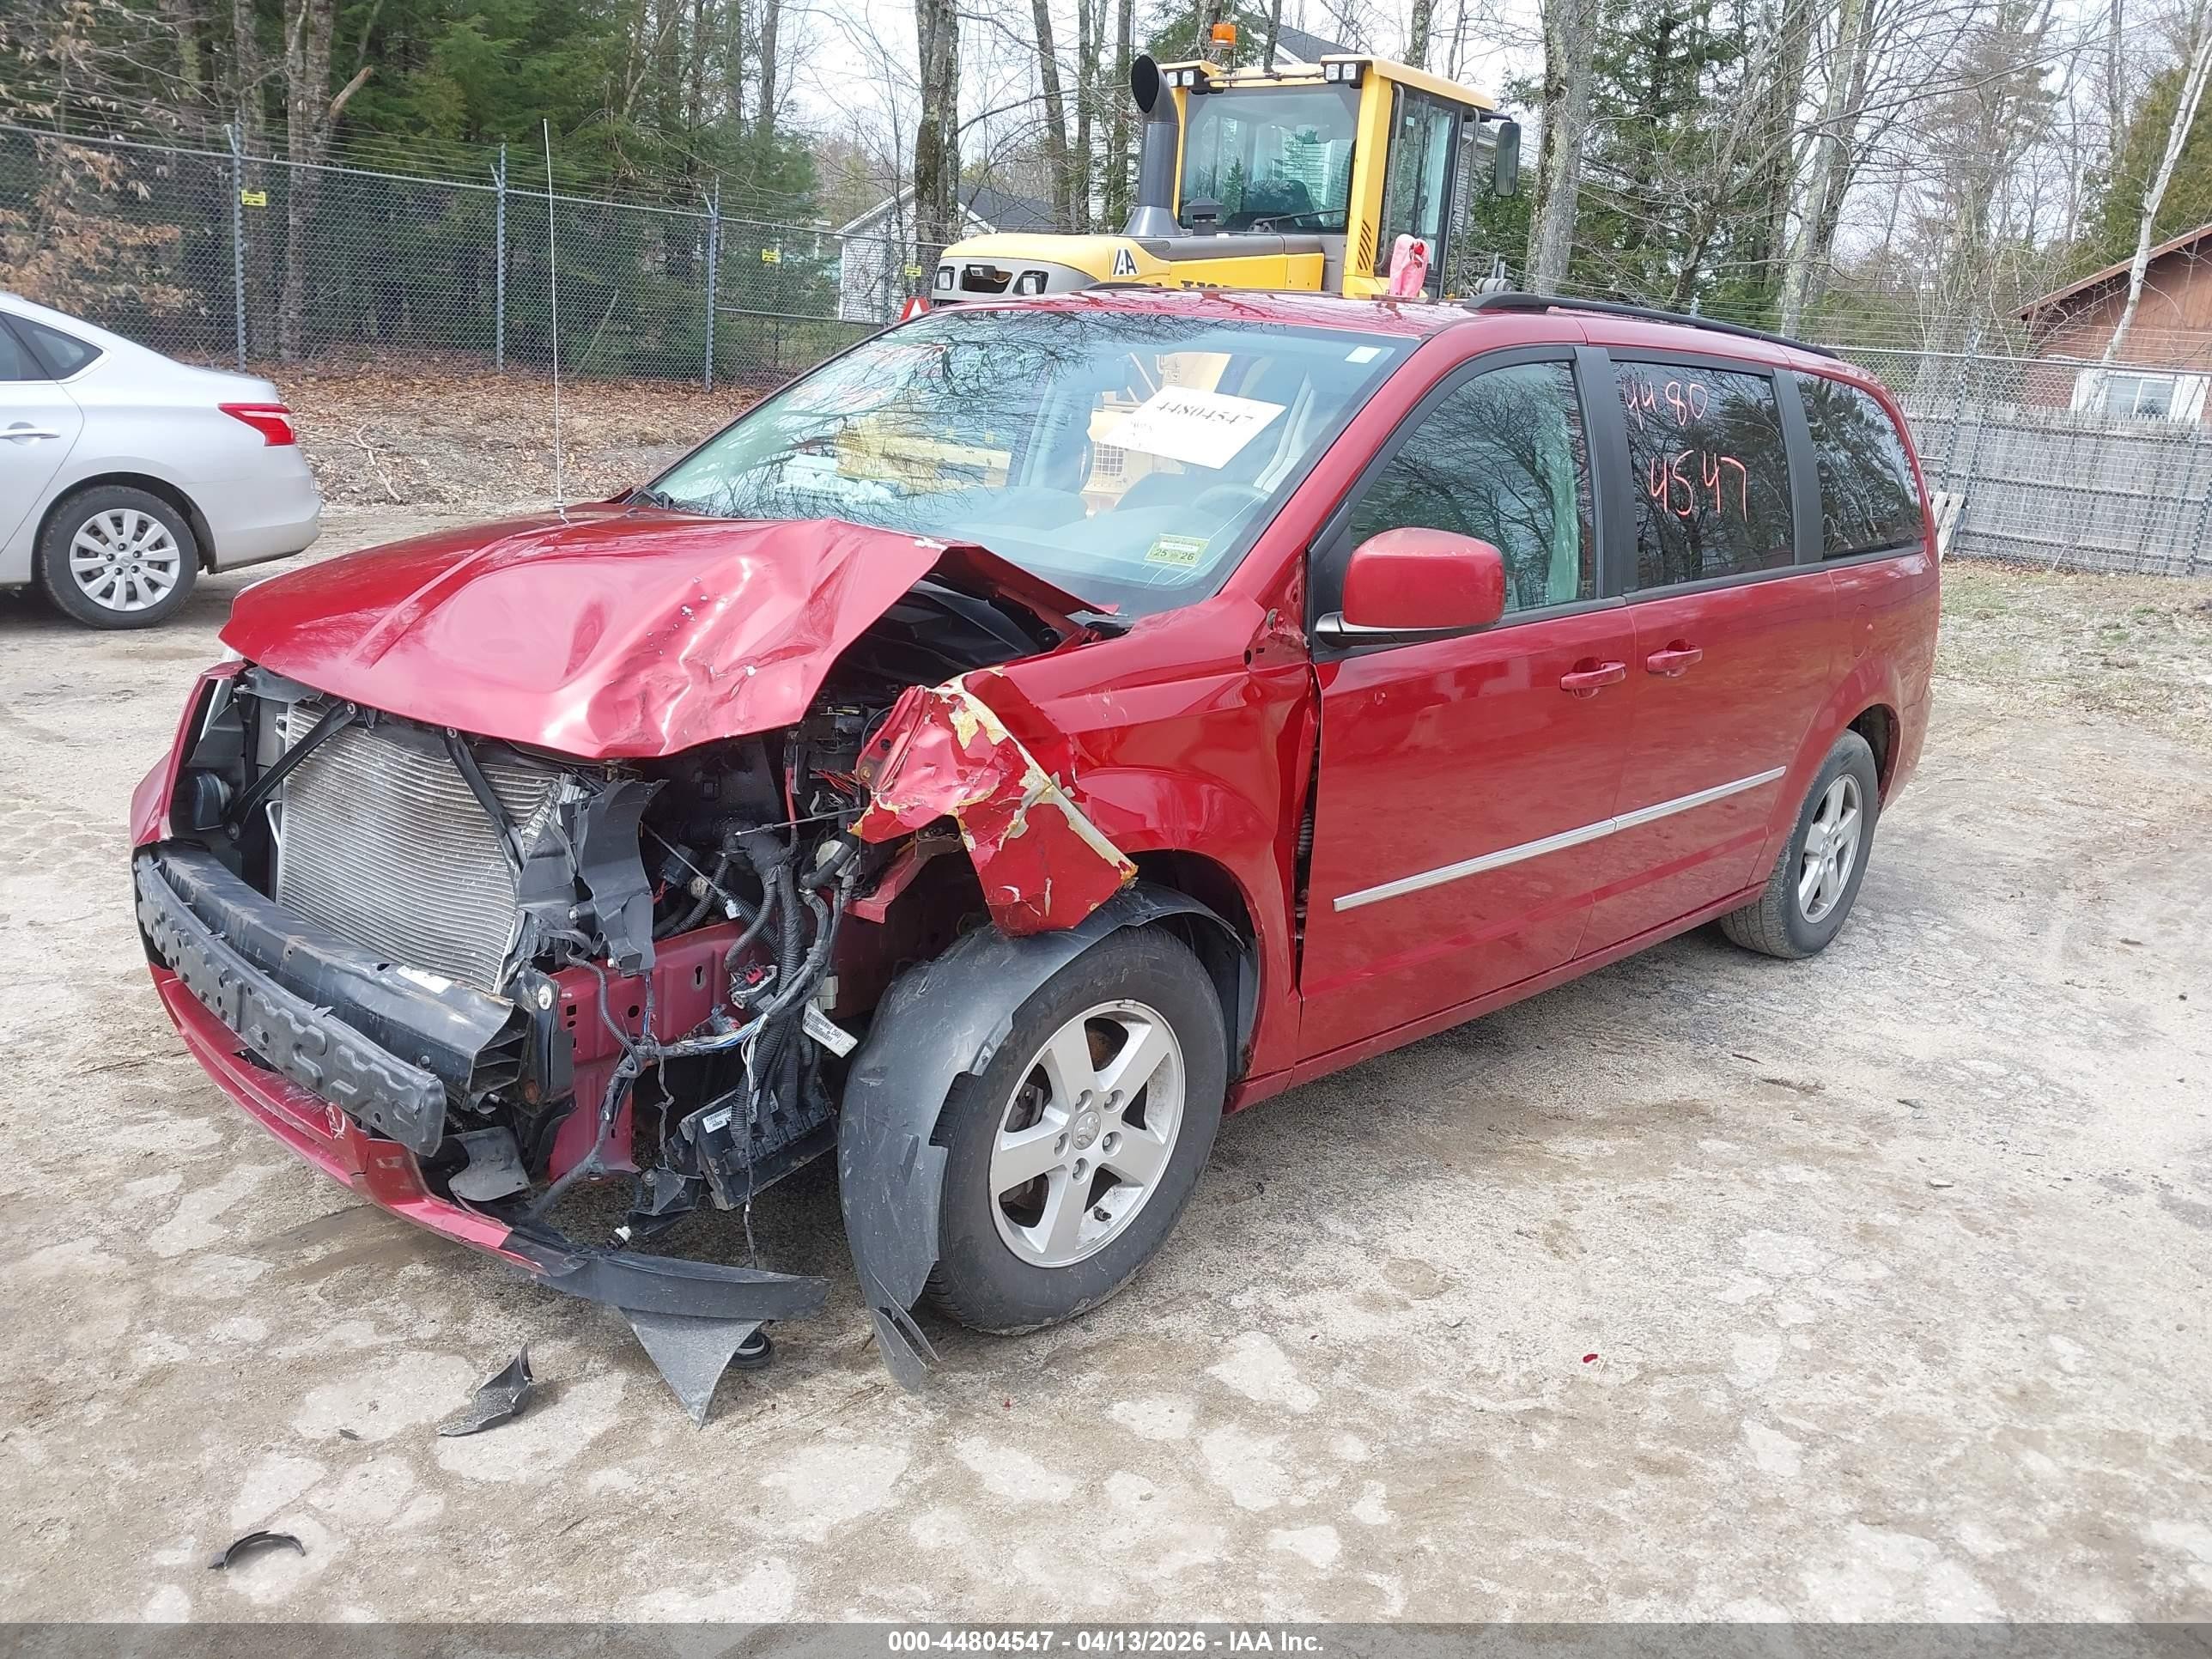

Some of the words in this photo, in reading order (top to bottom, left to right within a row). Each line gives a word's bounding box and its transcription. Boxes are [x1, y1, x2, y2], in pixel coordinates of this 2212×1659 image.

[1650, 449, 1748, 522] 4547
[1153, 548, 1169, 557] 25
[1180, 552, 1195, 561] 26
